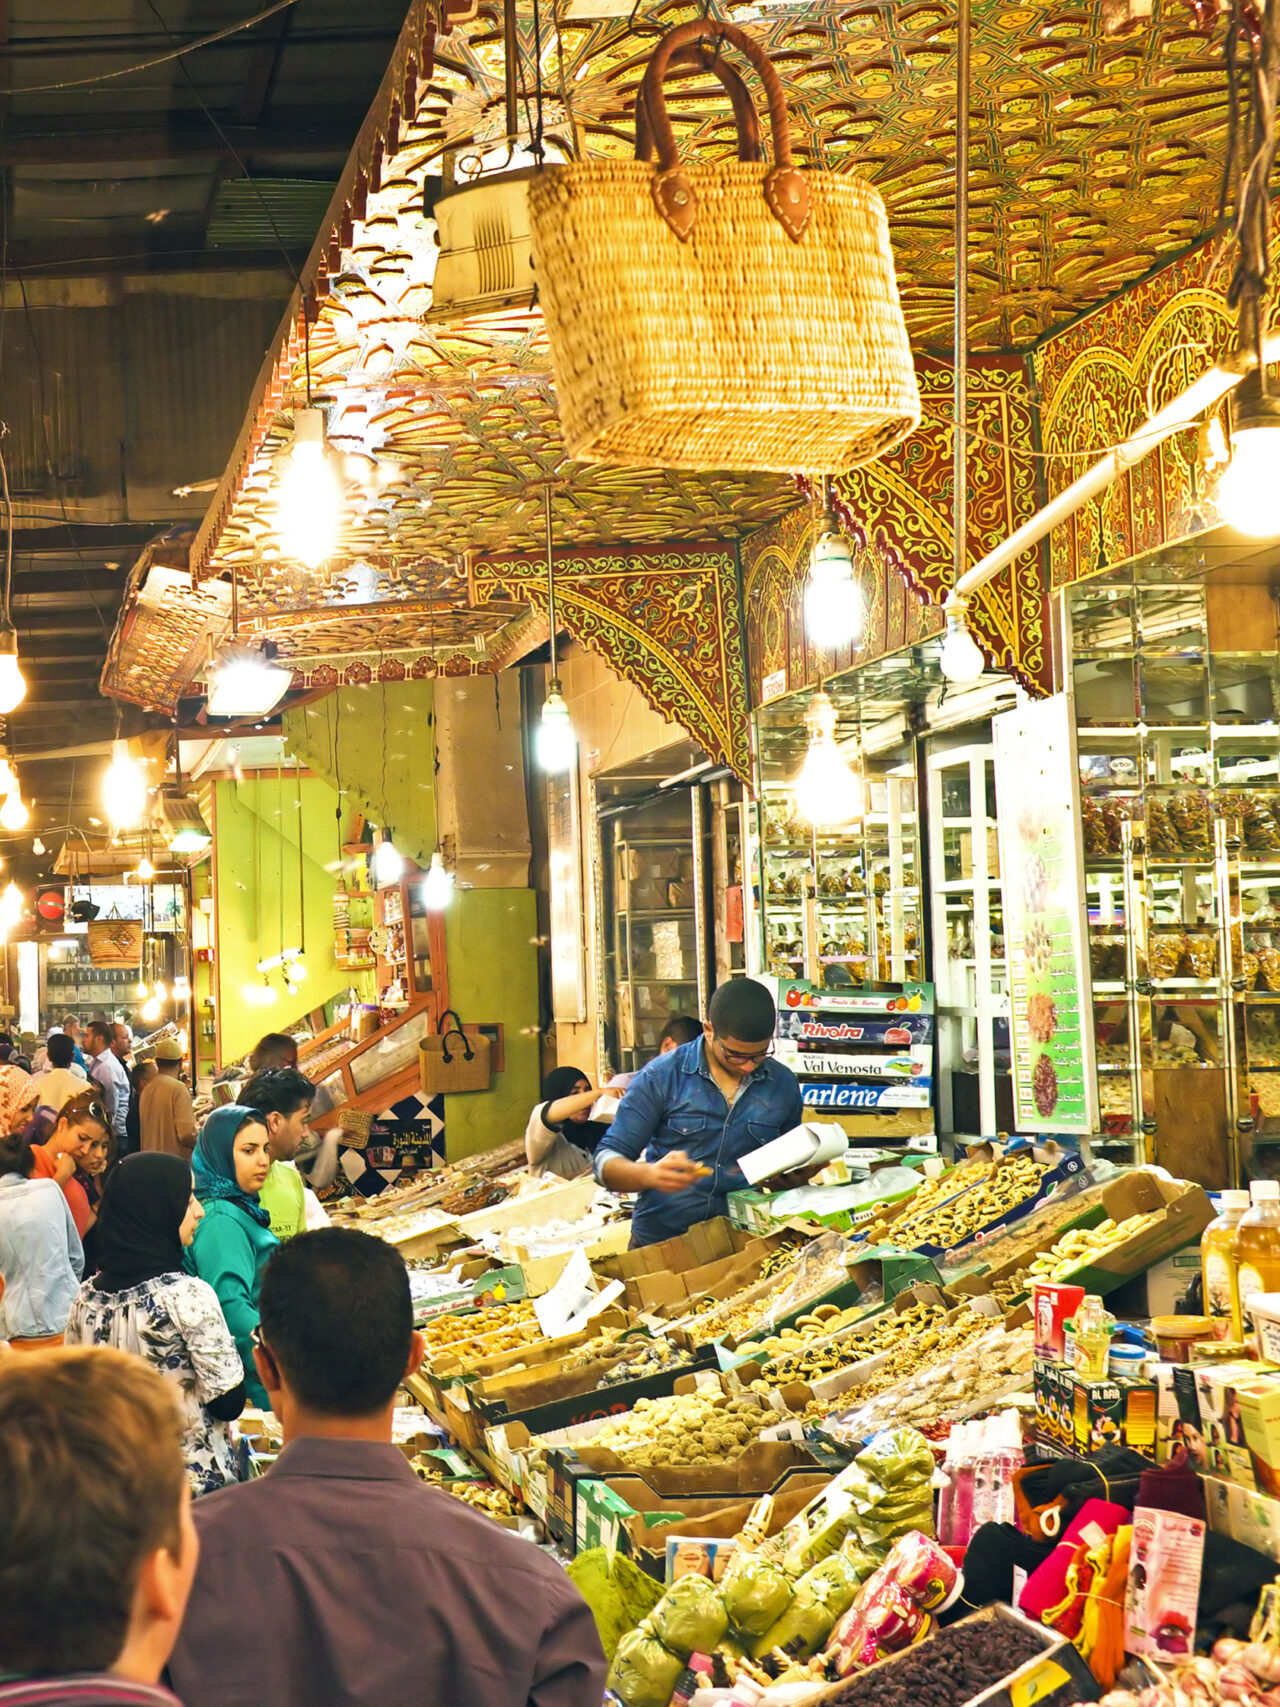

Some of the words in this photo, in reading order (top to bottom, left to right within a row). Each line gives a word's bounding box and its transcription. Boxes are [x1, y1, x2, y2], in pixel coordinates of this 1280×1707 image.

[830, 998, 848, 1006] Fruits
[850, 998, 857, 1006] de
[802, 1022, 865, 1041] Rivoira
[803, 1060, 824, 1074] Val
[828, 1060, 882, 1075] Venosta
[801, 1085, 878, 1107] arlene
[1092, 1389, 1102, 1400] AL
